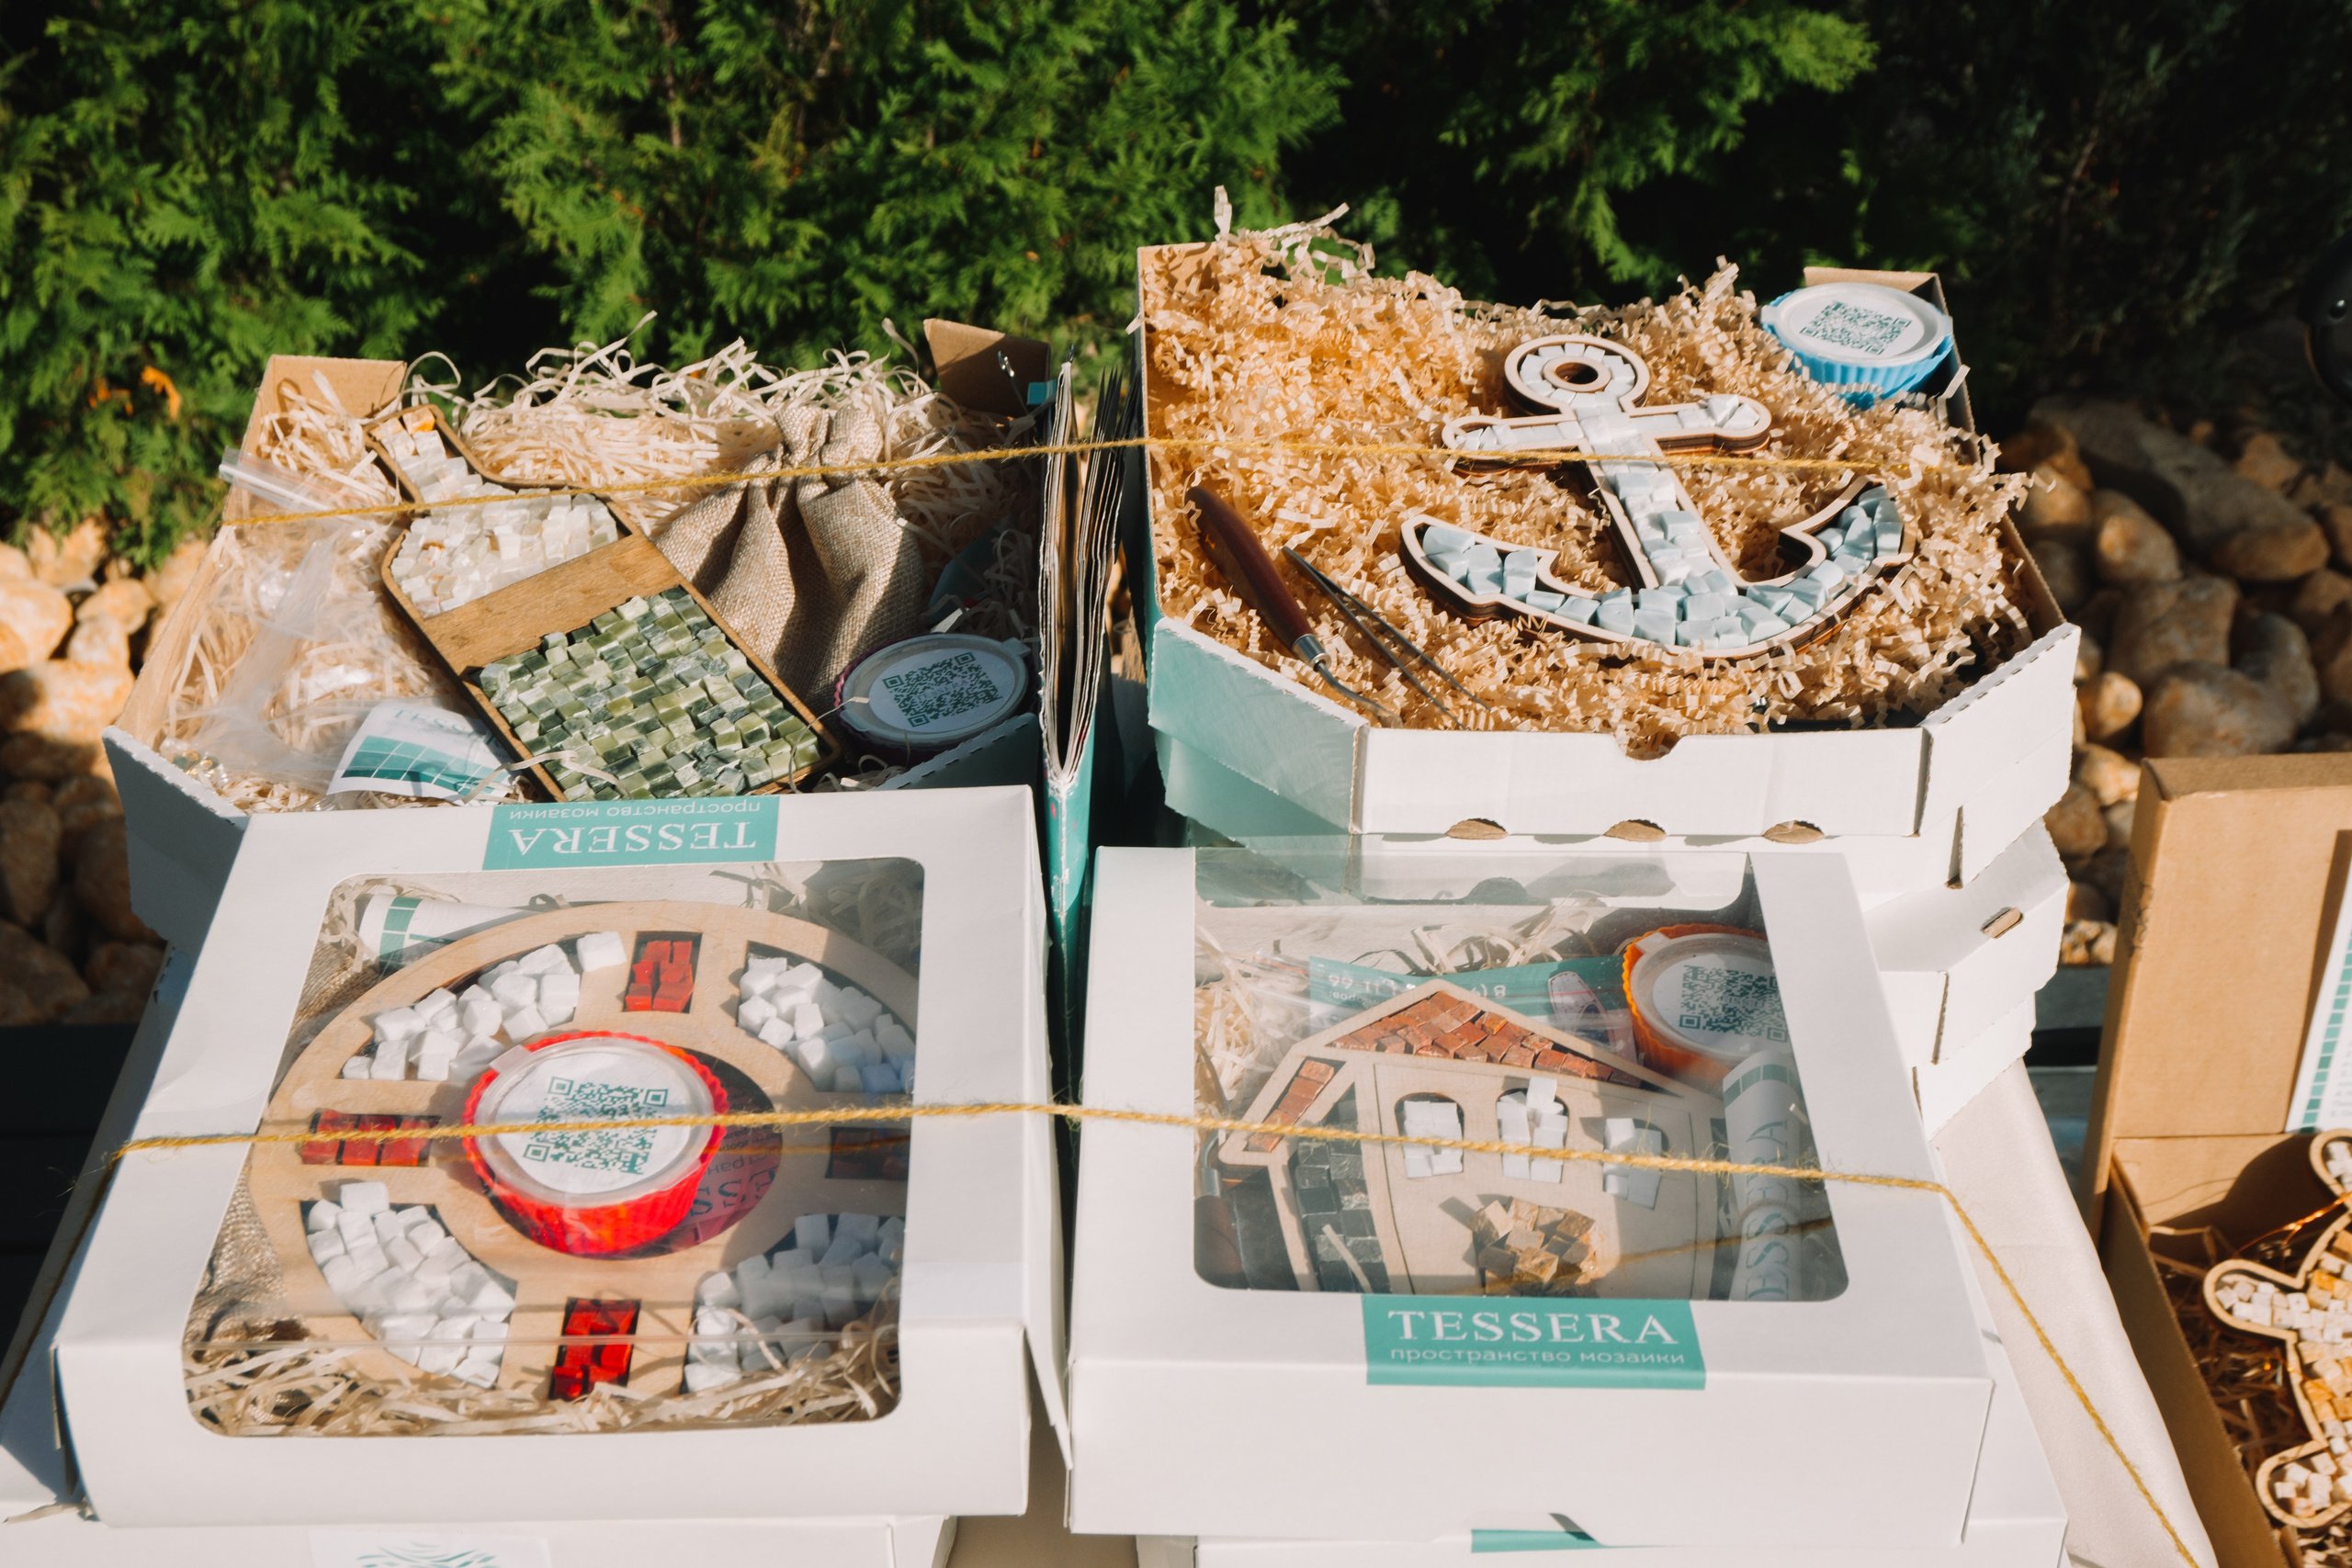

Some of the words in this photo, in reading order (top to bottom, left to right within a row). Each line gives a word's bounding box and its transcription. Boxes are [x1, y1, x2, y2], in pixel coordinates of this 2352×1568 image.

[509, 807, 599, 820] мозаики
[607, 799, 761, 818] пространство
[508, 821, 758, 856] TESSERA
[1493, 984, 1507, 999] 8
[1388, 1311, 1679, 1345] TESSERA
[1391, 1348, 1571, 1364] пространство
[1580, 1351, 1684, 1364] мозаики
